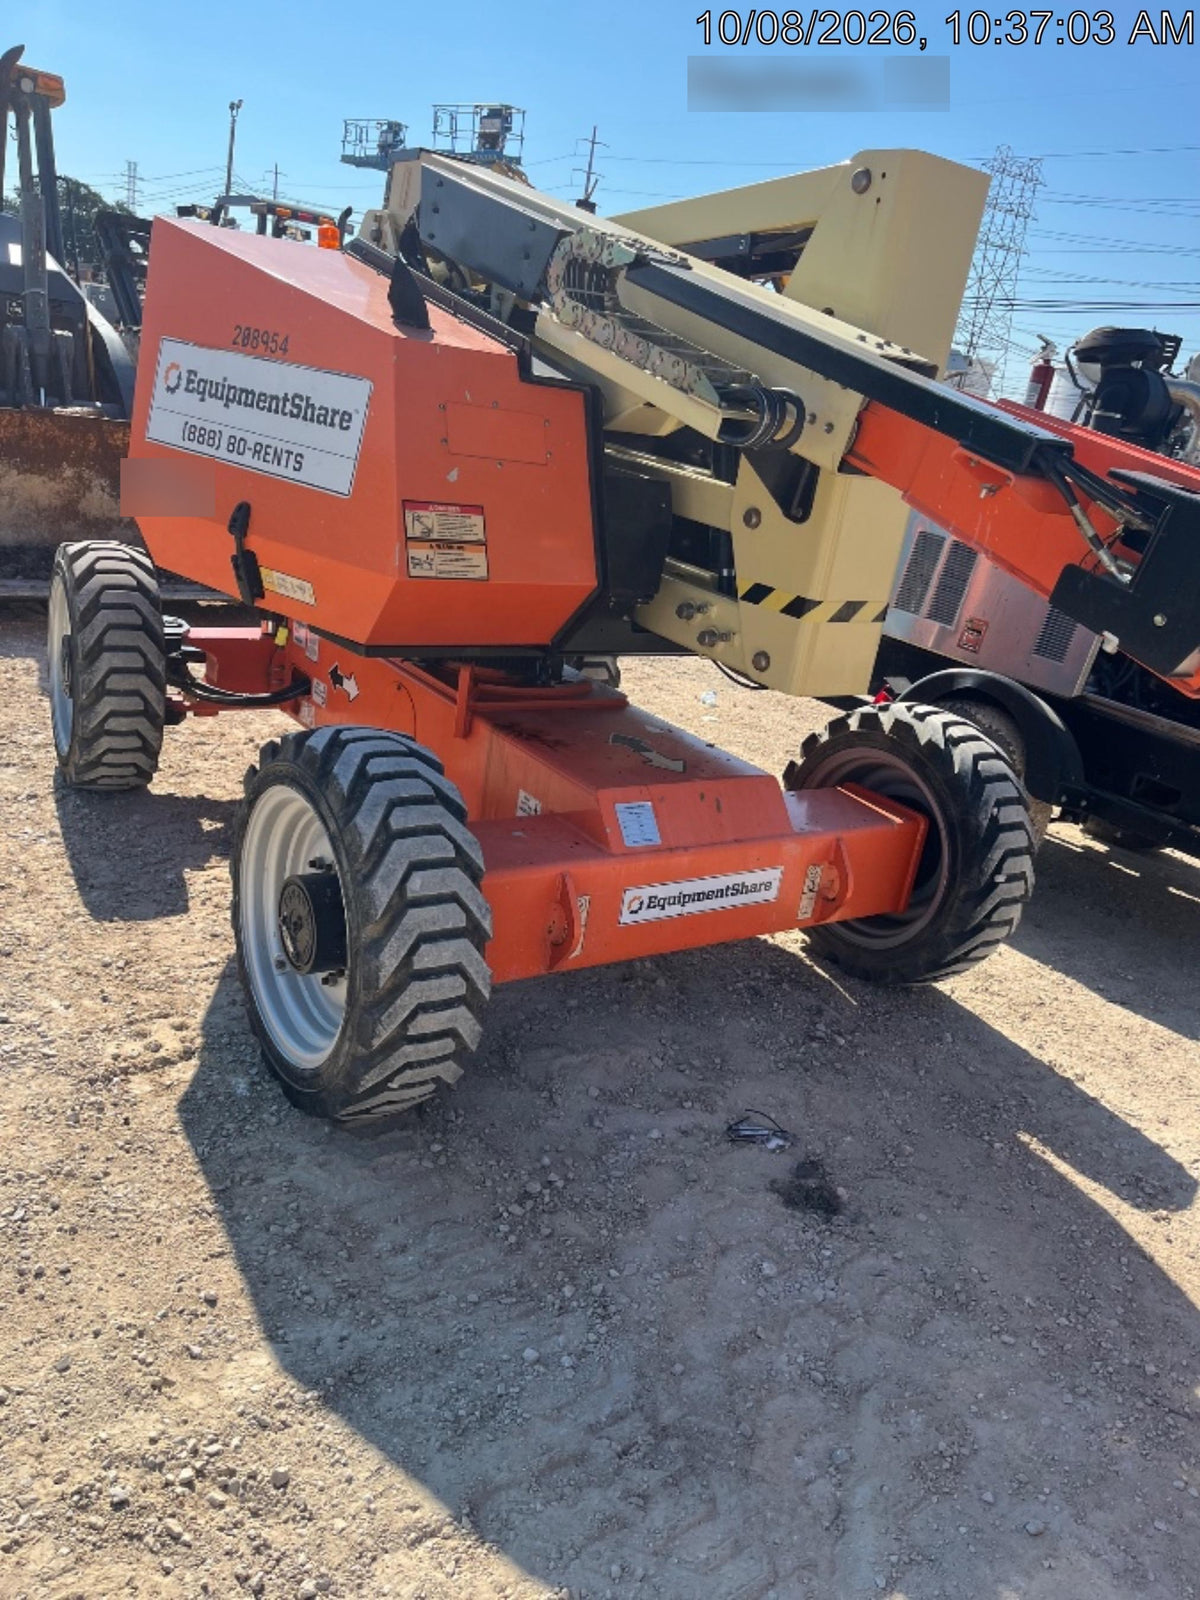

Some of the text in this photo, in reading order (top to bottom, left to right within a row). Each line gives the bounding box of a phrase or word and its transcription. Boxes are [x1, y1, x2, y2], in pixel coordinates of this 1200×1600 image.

[184, 369, 352, 431] EquipmentShare
[182, 421, 305, 472] (888) 80-RENTS
[645, 880, 772, 911] EquipmentShare
